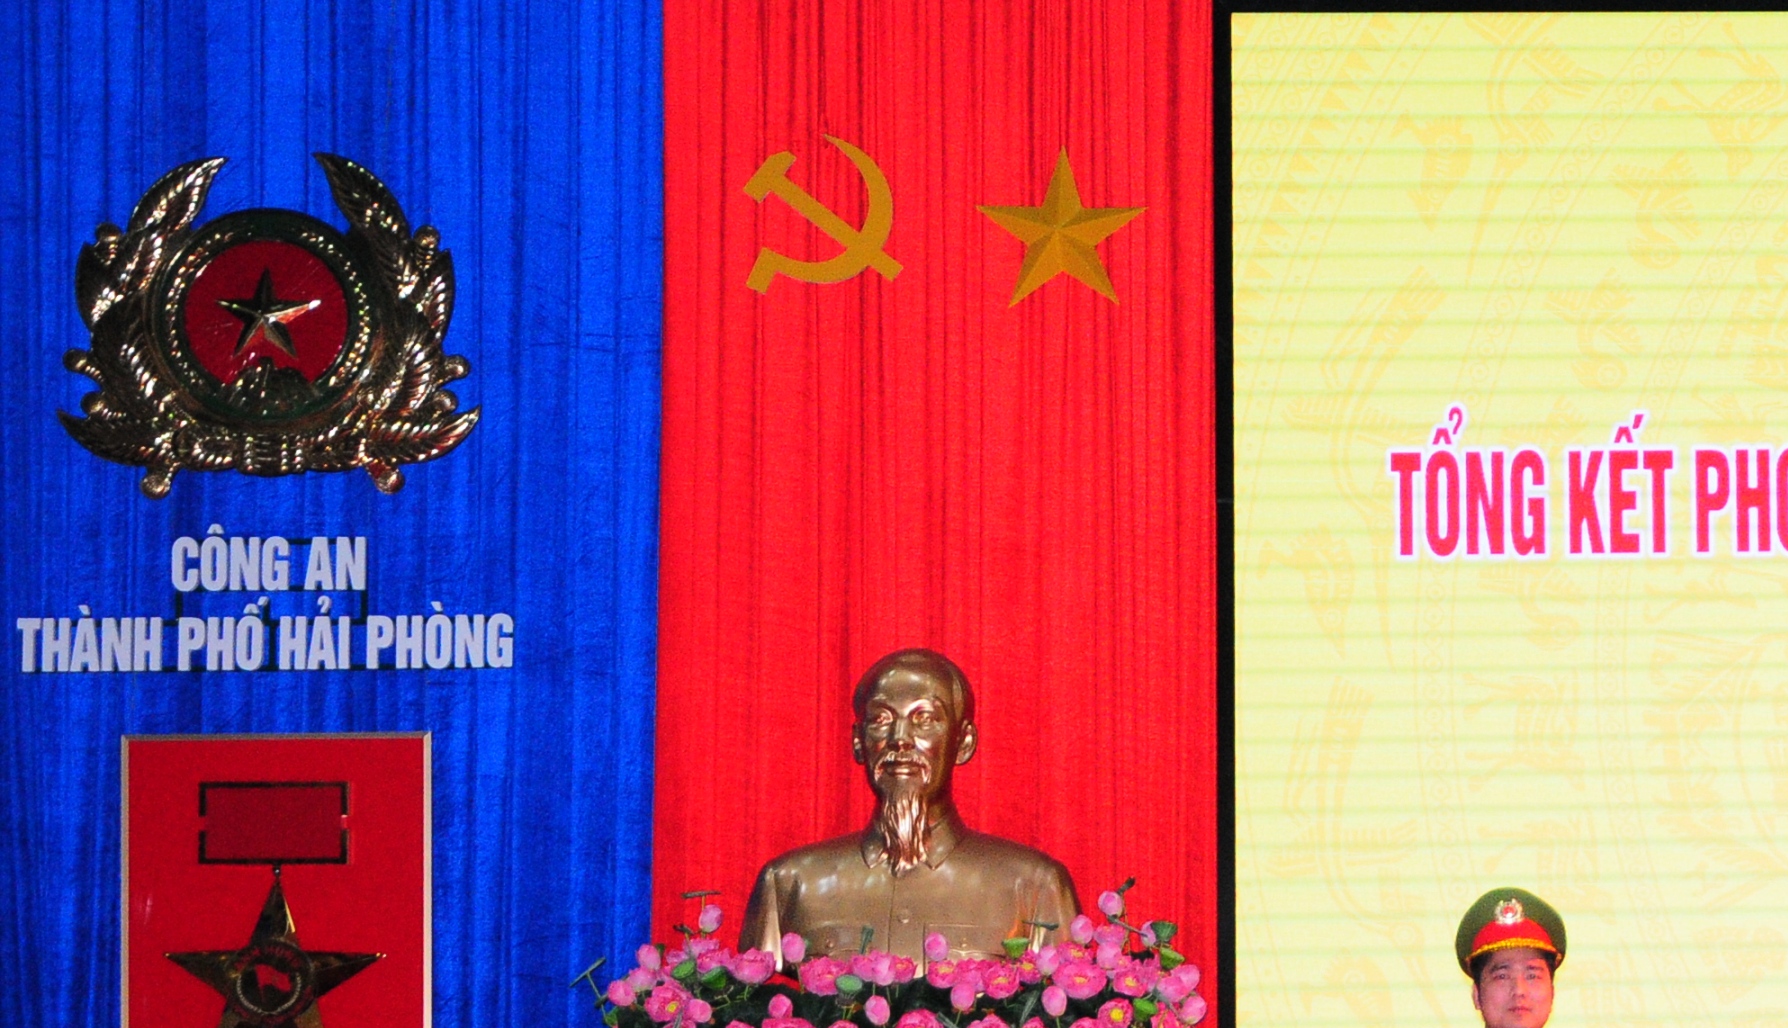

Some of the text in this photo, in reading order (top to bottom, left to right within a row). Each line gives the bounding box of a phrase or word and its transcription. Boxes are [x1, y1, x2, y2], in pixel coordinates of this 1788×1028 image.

[1390, 408, 1545, 557] TỔNG
[1569, 414, 1672, 554] KẾT
[171, 523, 366, 591] CÔNG AN
[17, 595, 514, 673] THÀNH PHỐ HẢI PHÒNG
